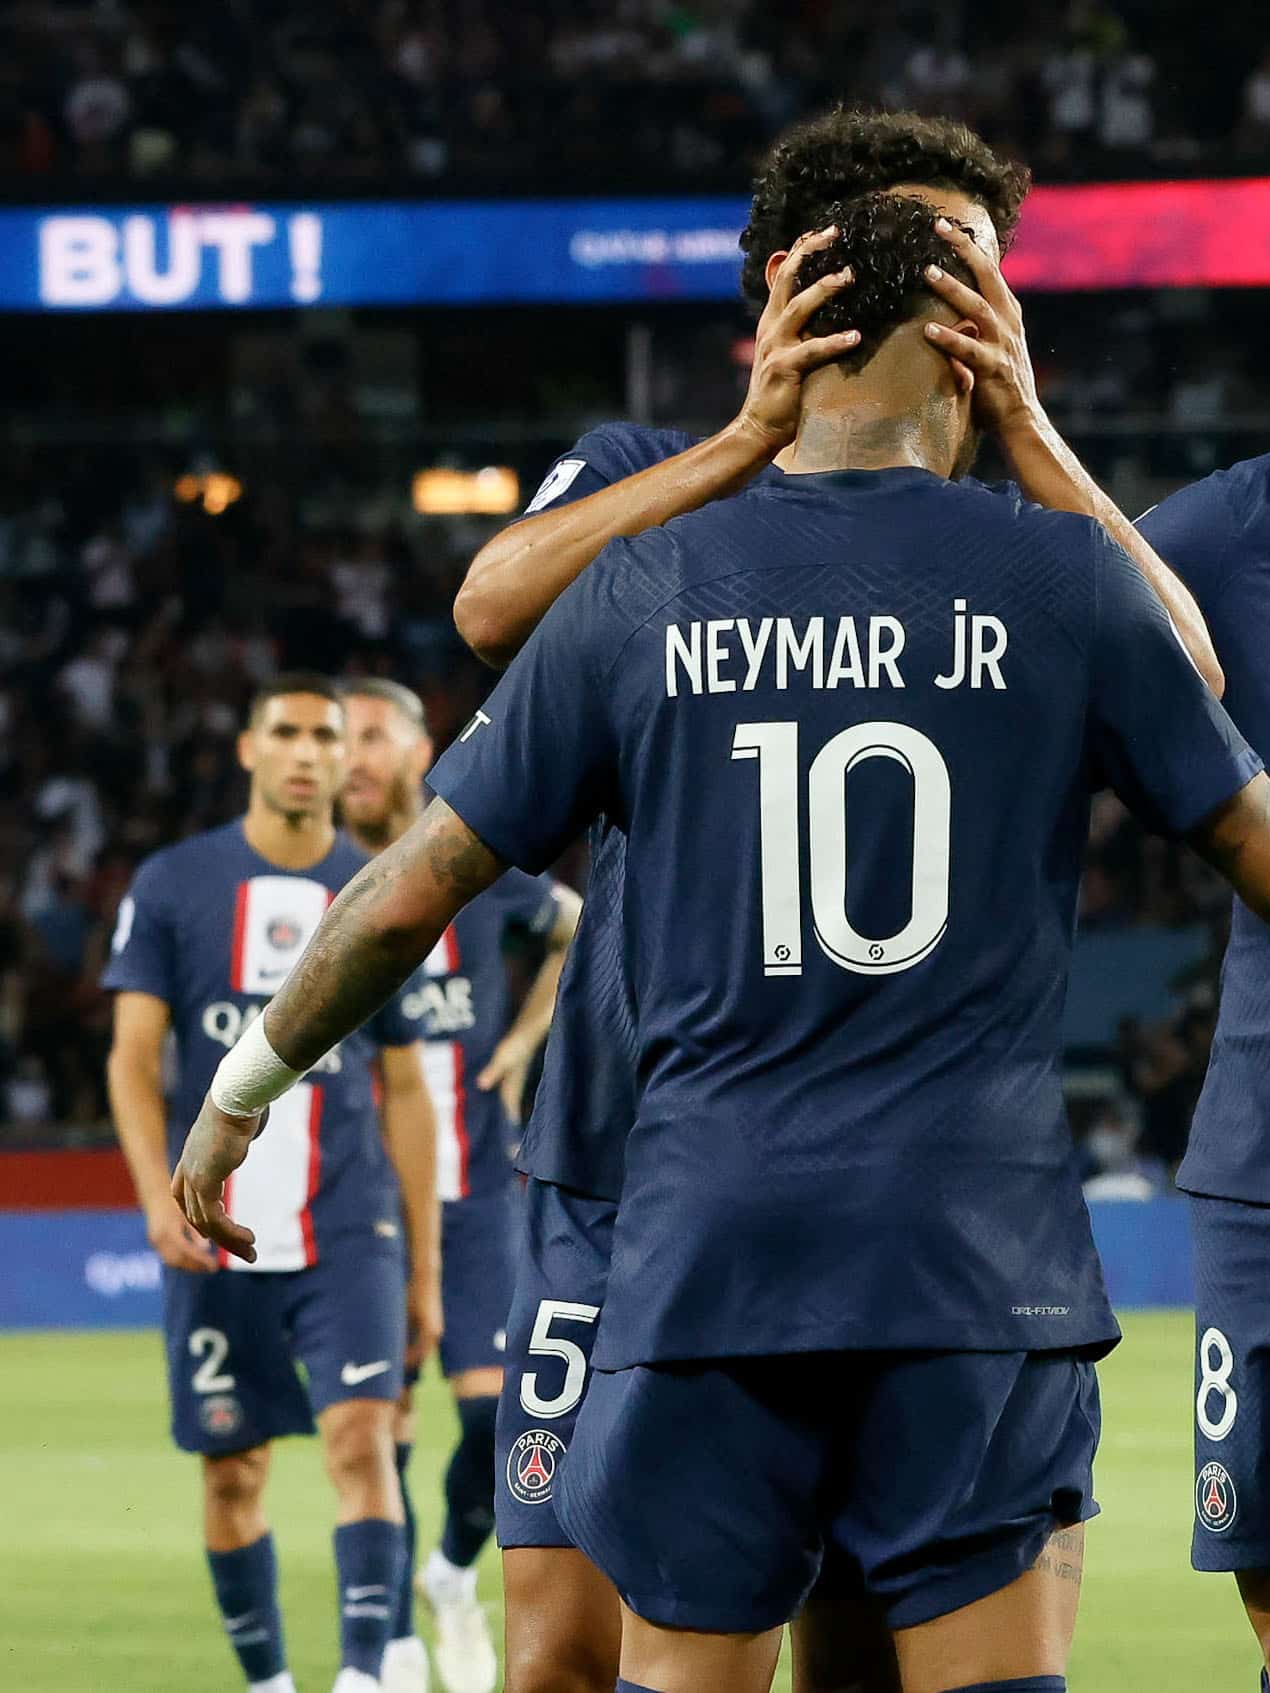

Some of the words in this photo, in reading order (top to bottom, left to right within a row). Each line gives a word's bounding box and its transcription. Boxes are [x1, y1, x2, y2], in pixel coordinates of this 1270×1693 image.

[665, 615, 906, 697] NEYMAR
[730, 720, 952, 977] 10
[188, 1328, 236, 1393] 2
[519, 1299, 601, 1420] 5
[1196, 1327, 1238, 1441] 8
[518, 1432, 559, 1452] PARIS
